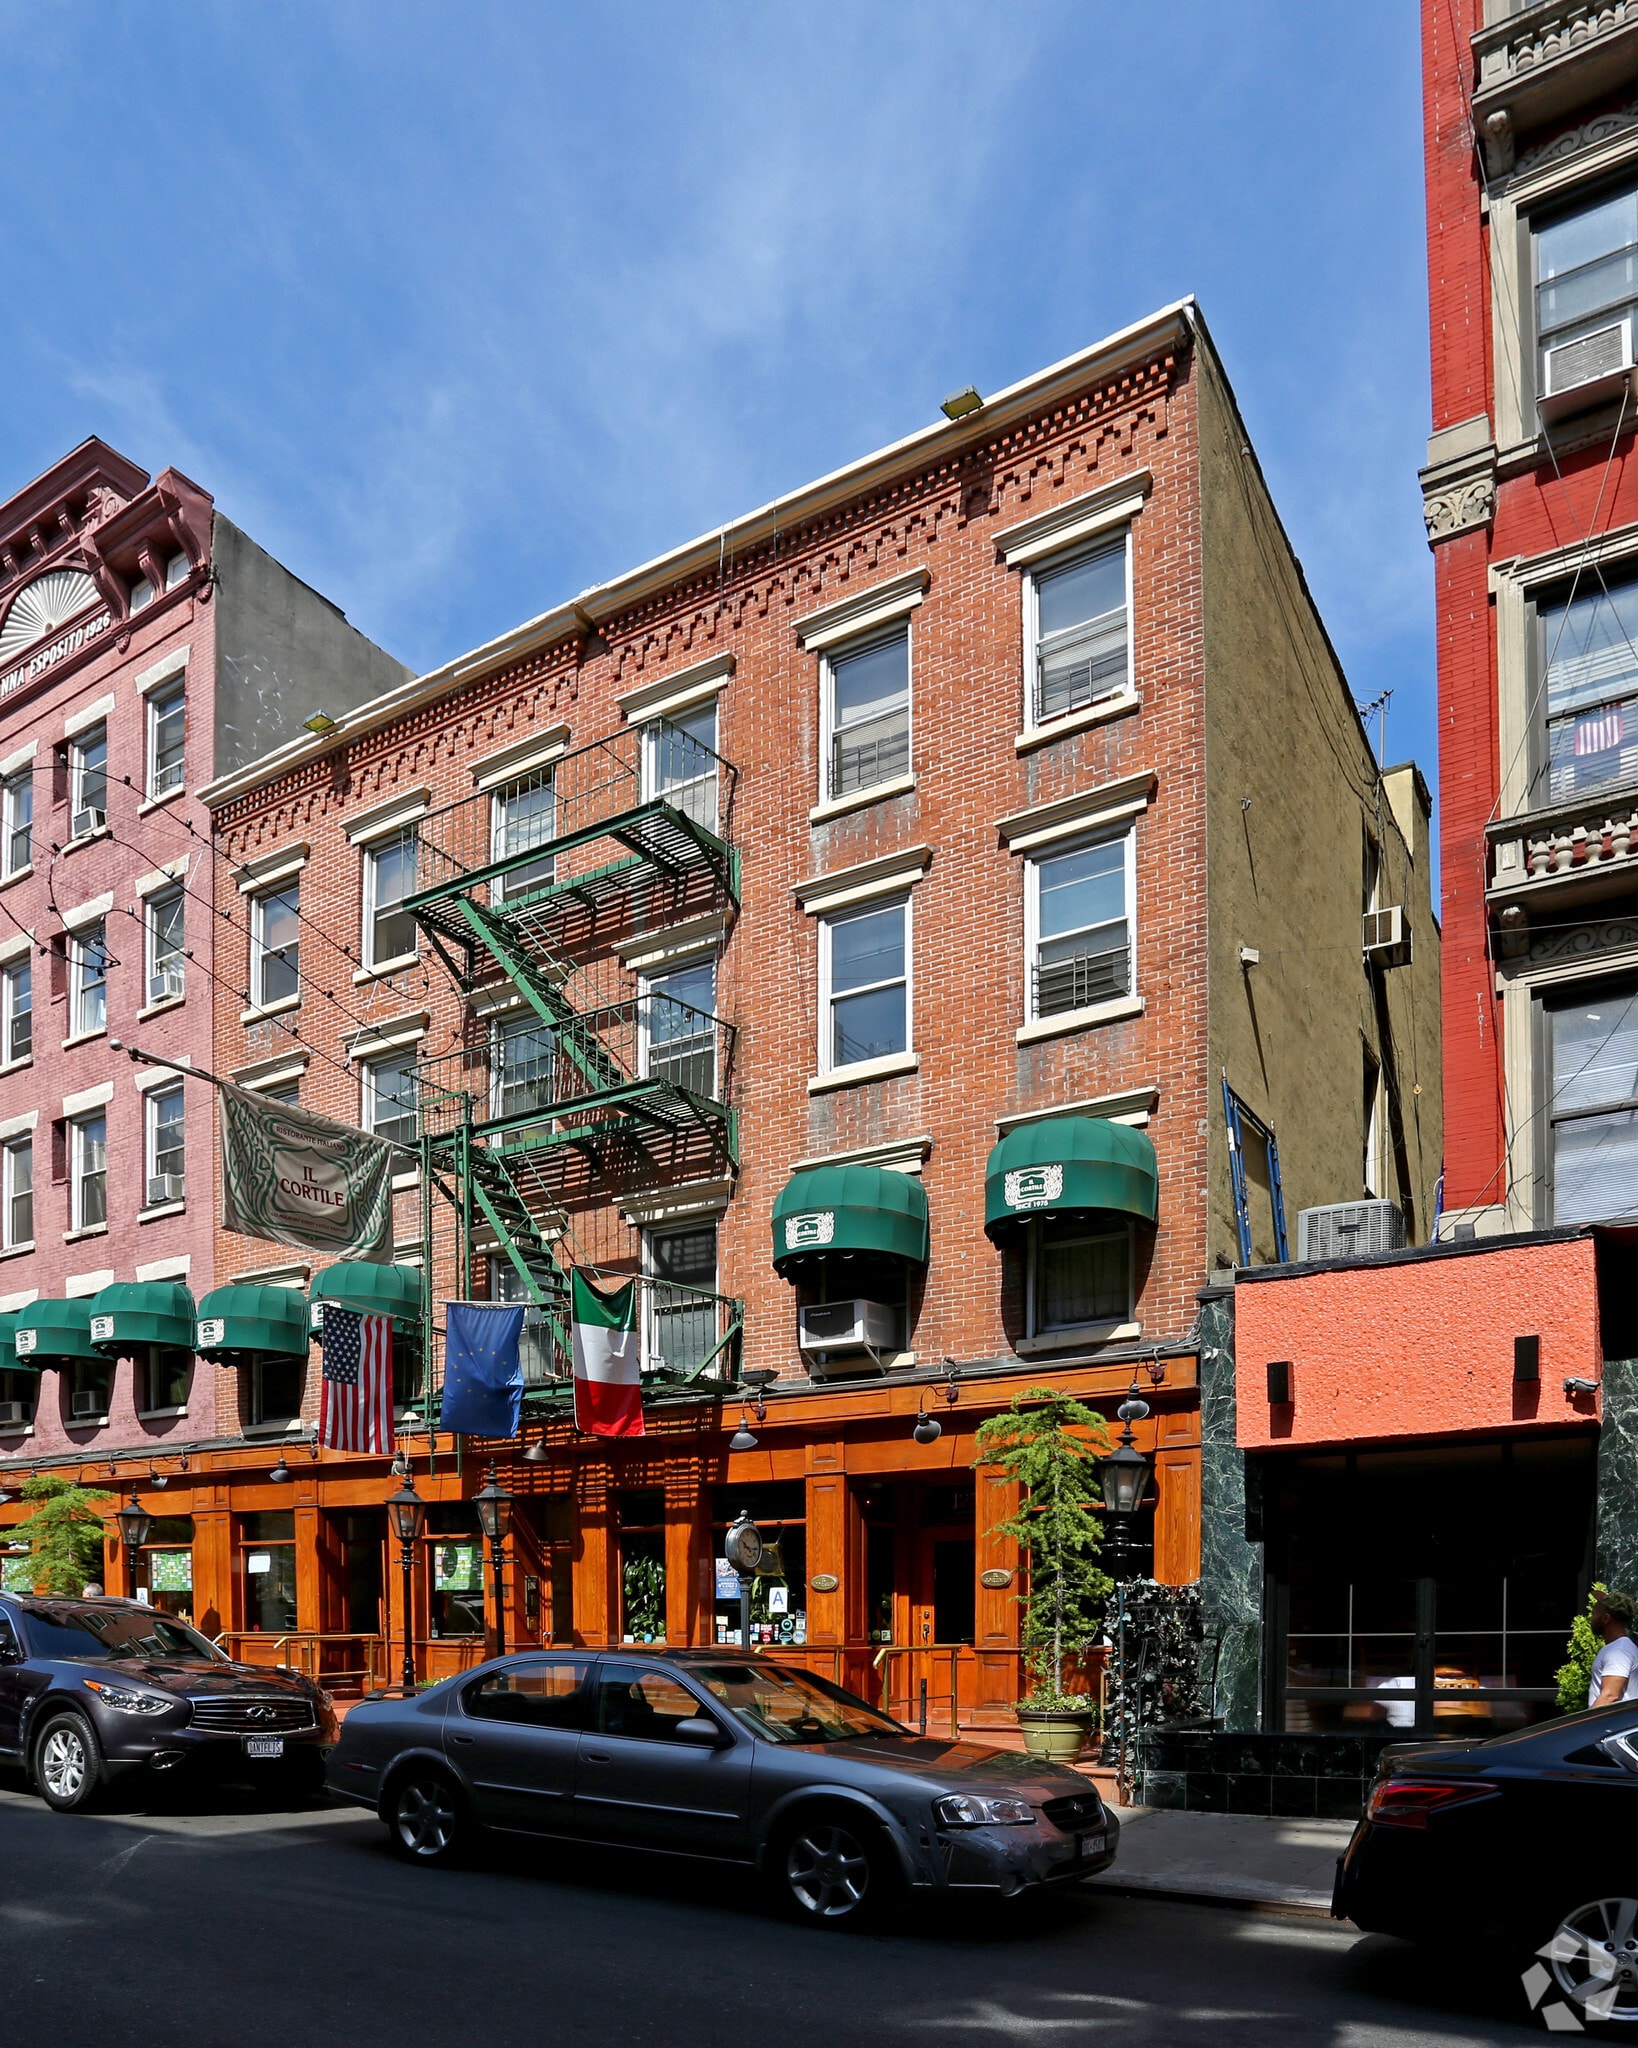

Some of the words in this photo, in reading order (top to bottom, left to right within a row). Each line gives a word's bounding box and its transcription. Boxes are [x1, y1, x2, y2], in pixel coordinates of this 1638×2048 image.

[30, 628, 84, 679] ESPOSITO
[86, 611, 111, 639] 1926
[276, 1126, 316, 1143] RISTORANTE
[316, 1138, 346, 1152] ITALIANO
[303, 1166, 318, 1183] IL
[280, 1178, 345, 1207] CORTILE
[1020, 1183, 1043, 1192] CORTILE
[1015, 1202, 1032, 1210] SINCE
[1033, 1200, 1049, 1208] 1975
[772, 1590, 784, 1606] A
[249, 1742, 281, 1753] DANIELIS
